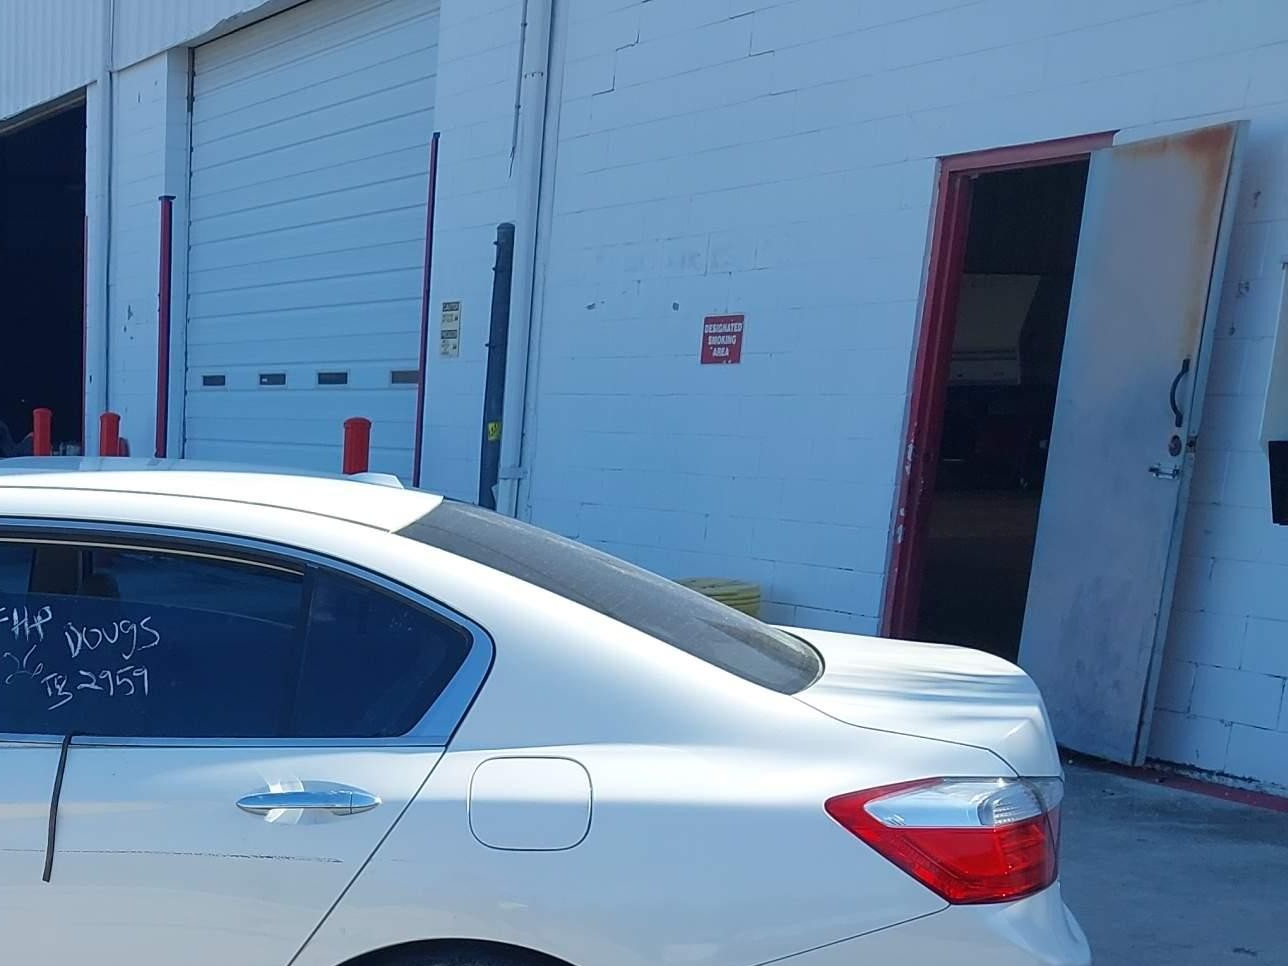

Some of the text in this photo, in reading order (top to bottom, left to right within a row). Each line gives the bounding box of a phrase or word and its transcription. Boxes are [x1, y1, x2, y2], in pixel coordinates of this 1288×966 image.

[704, 323, 743, 333] DESIGNATED
[708, 335, 737, 345] SMOKING
[712, 347, 729, 357] AREA
